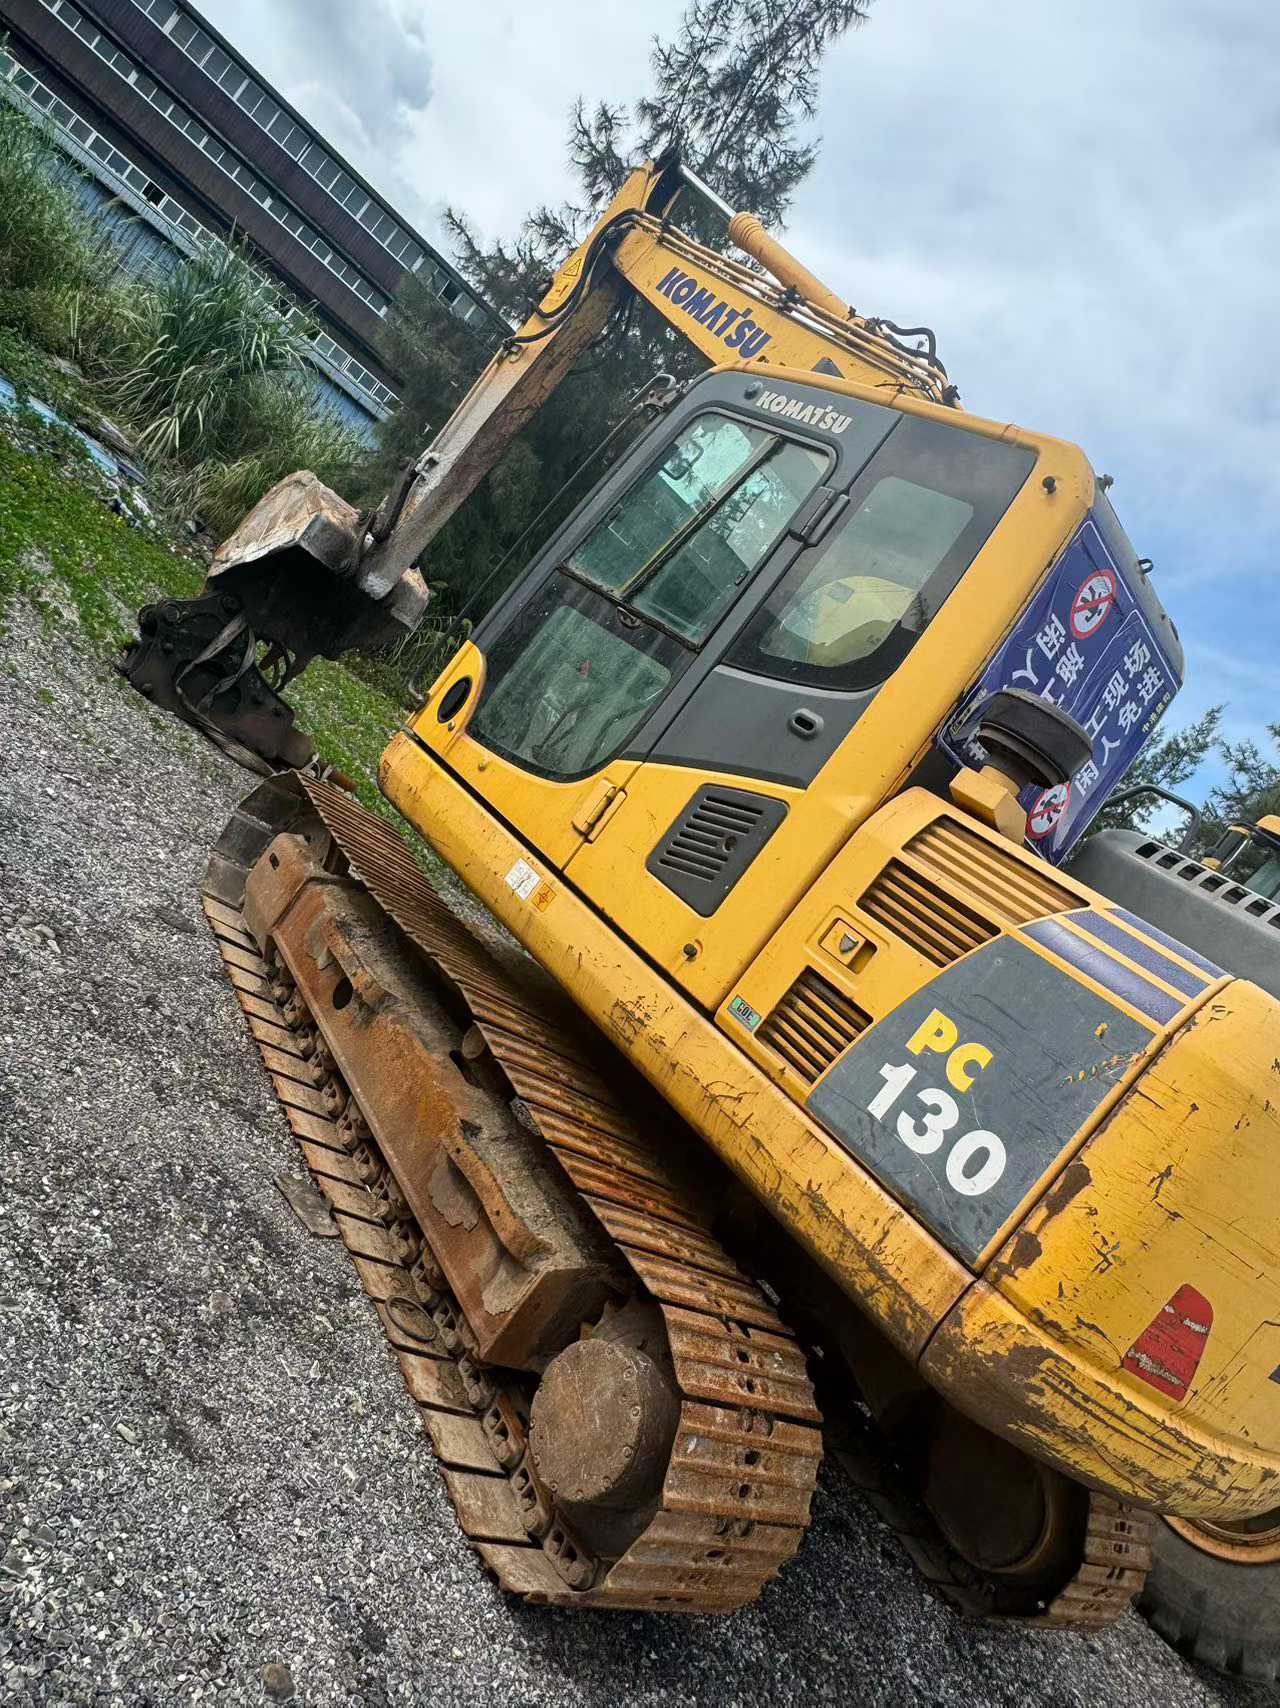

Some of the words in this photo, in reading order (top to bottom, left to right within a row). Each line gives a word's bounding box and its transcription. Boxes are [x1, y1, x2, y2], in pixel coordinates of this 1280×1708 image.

[655, 267, 772, 358] KOMATSU
[755, 391, 852, 434] KOMATSU
[1074, 666, 1164, 796] 闲人免进
[905, 1008, 994, 1092] PC
[866, 1062, 1007, 1196] 130
